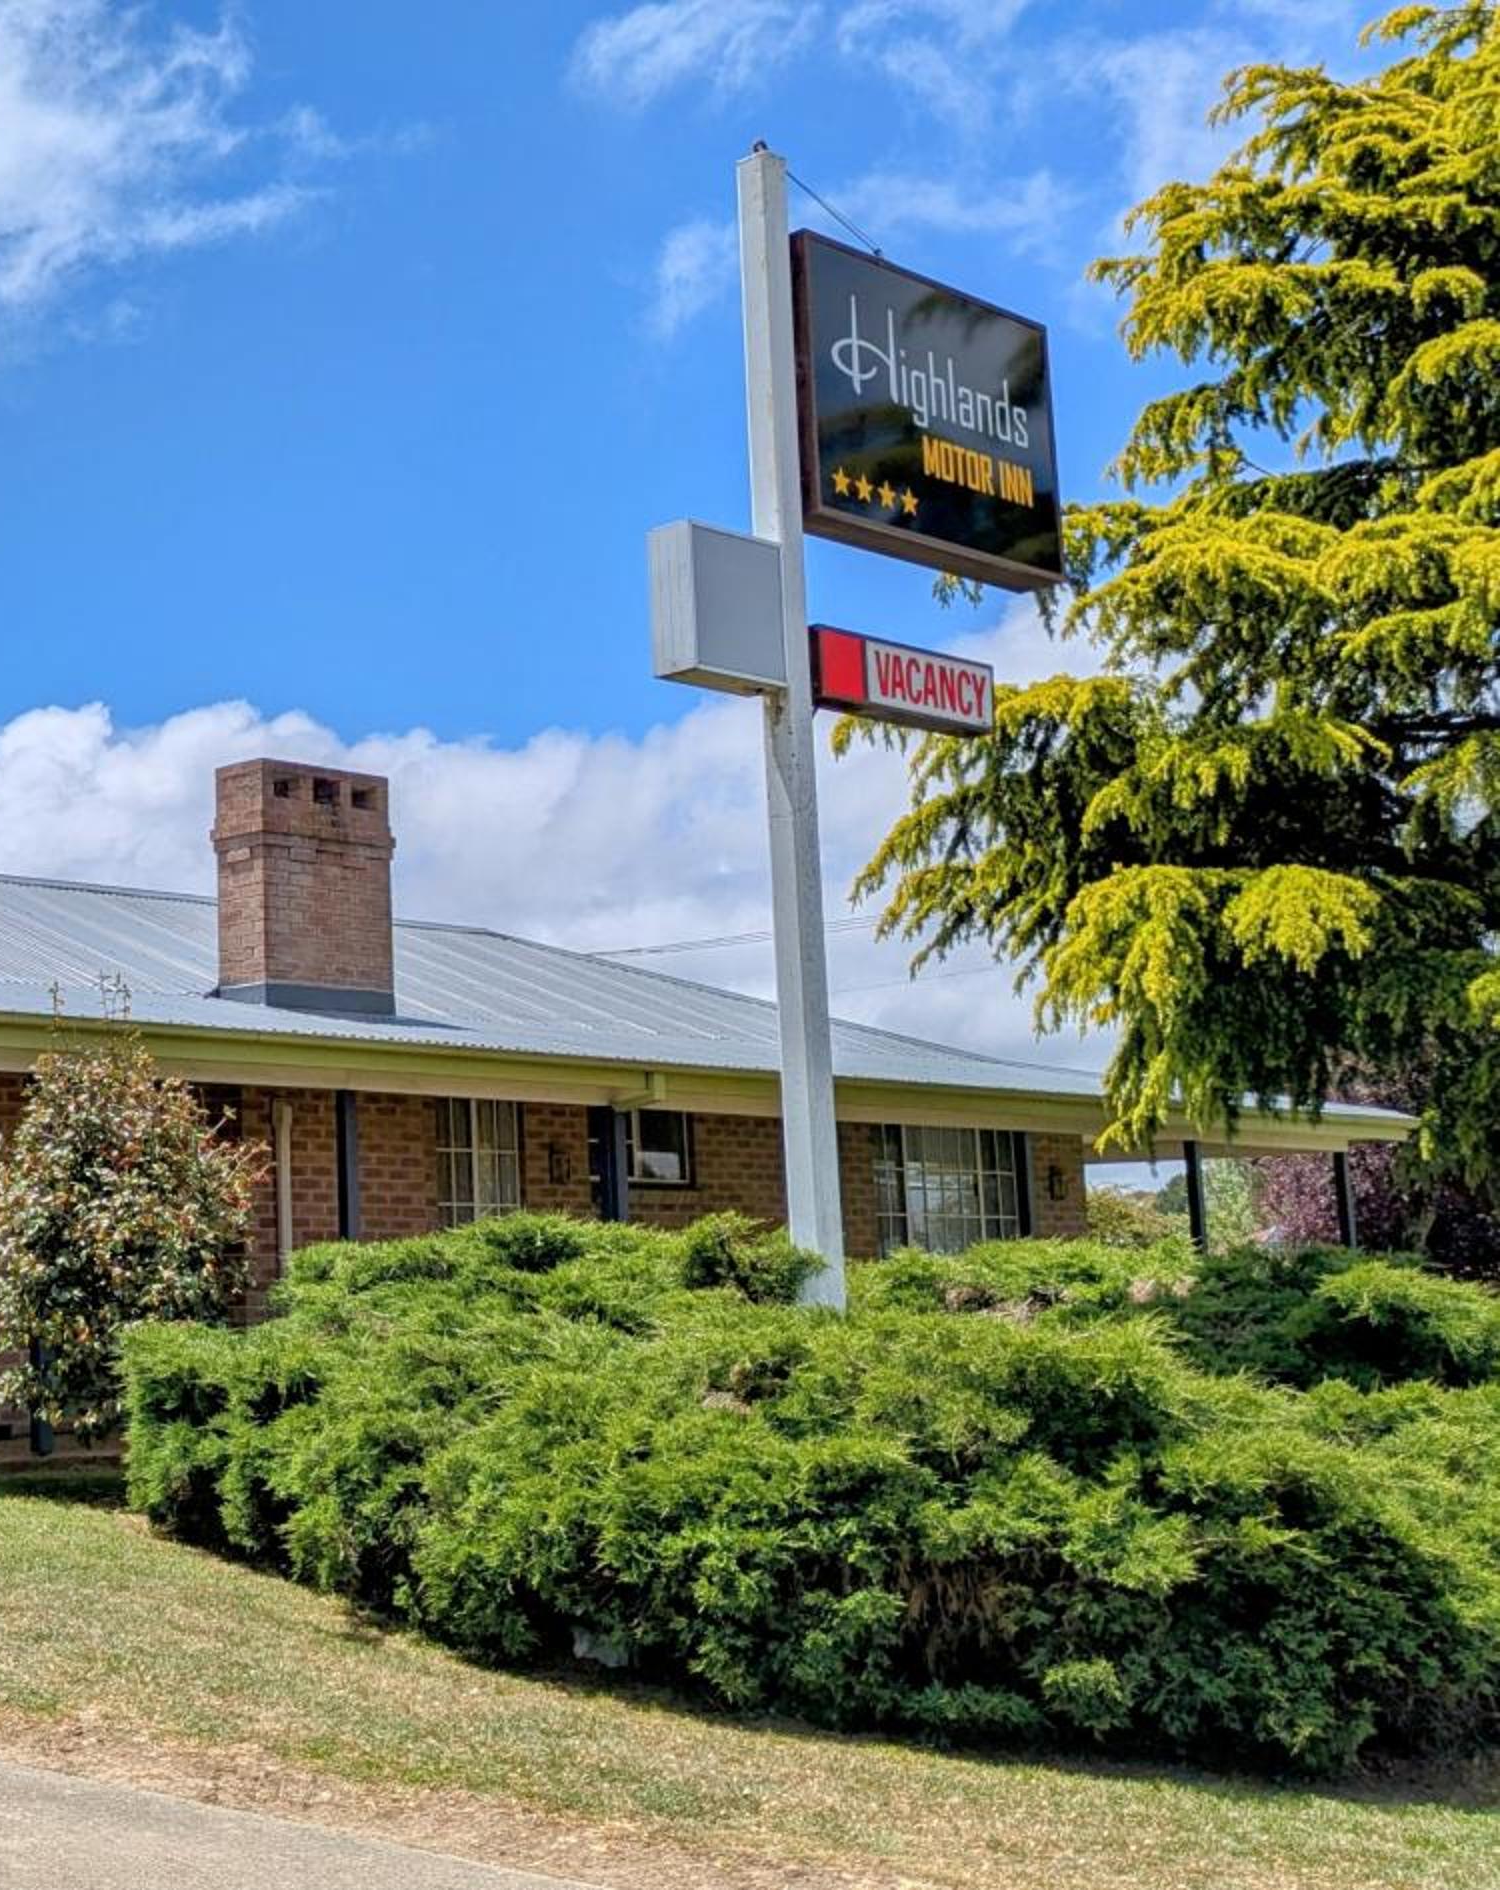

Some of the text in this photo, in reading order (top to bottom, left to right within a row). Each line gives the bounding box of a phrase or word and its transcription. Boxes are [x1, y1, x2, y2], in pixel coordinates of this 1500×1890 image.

[831, 294, 1029, 449] Highlands
[921, 435, 1034, 508] MOTOR INN
[875, 650, 986, 719] VACANCY
